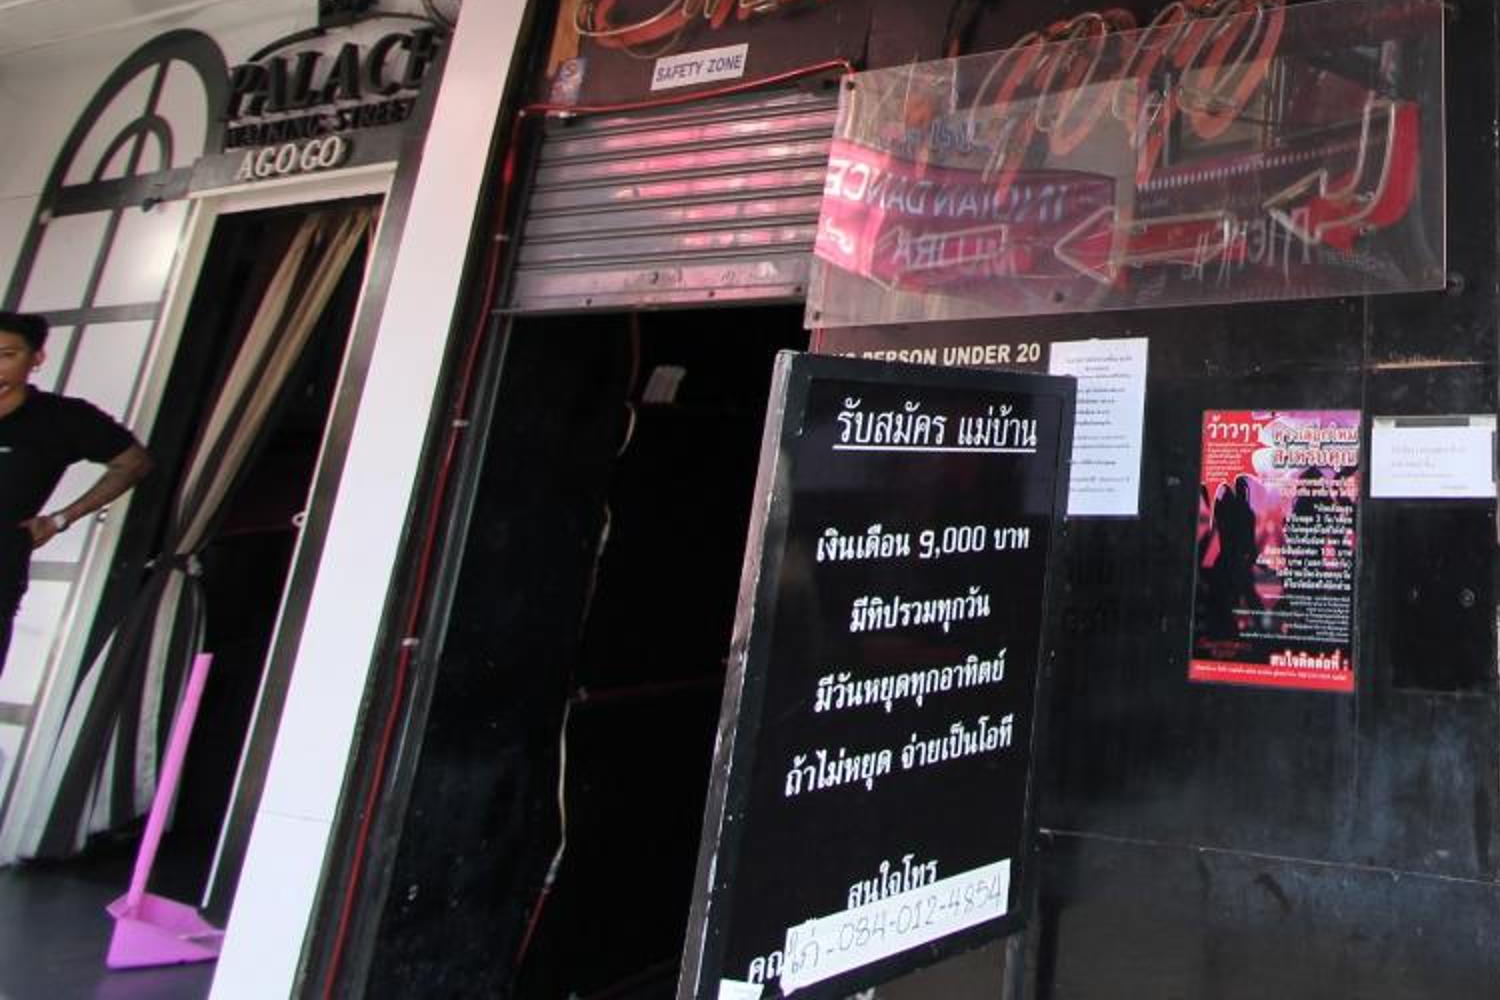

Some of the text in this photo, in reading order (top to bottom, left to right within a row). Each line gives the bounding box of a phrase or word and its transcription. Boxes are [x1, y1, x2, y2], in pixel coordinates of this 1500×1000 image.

[656, 54, 743, 83] SAFETY ZONE
[944, 344, 1011, 366] UNDER
[1016, 343, 1041, 363] 20
[836, 397, 1038, 447] รับสมัคร แม่บ้าน
[815, 523, 1030, 562] เงินเดือน 9,000 บาท
[849, 586, 992, 634] มีทิปรวมทุกวัน
[813, 647, 1007, 714] มีวันหยุดทุกอาทิตย์
[785, 713, 1013, 799] ถ้าไม่หยุด จ่ายเป็นโอที
[847, 853, 940, 909] สนใจโทร
[748, 949, 785, 986] คณ
